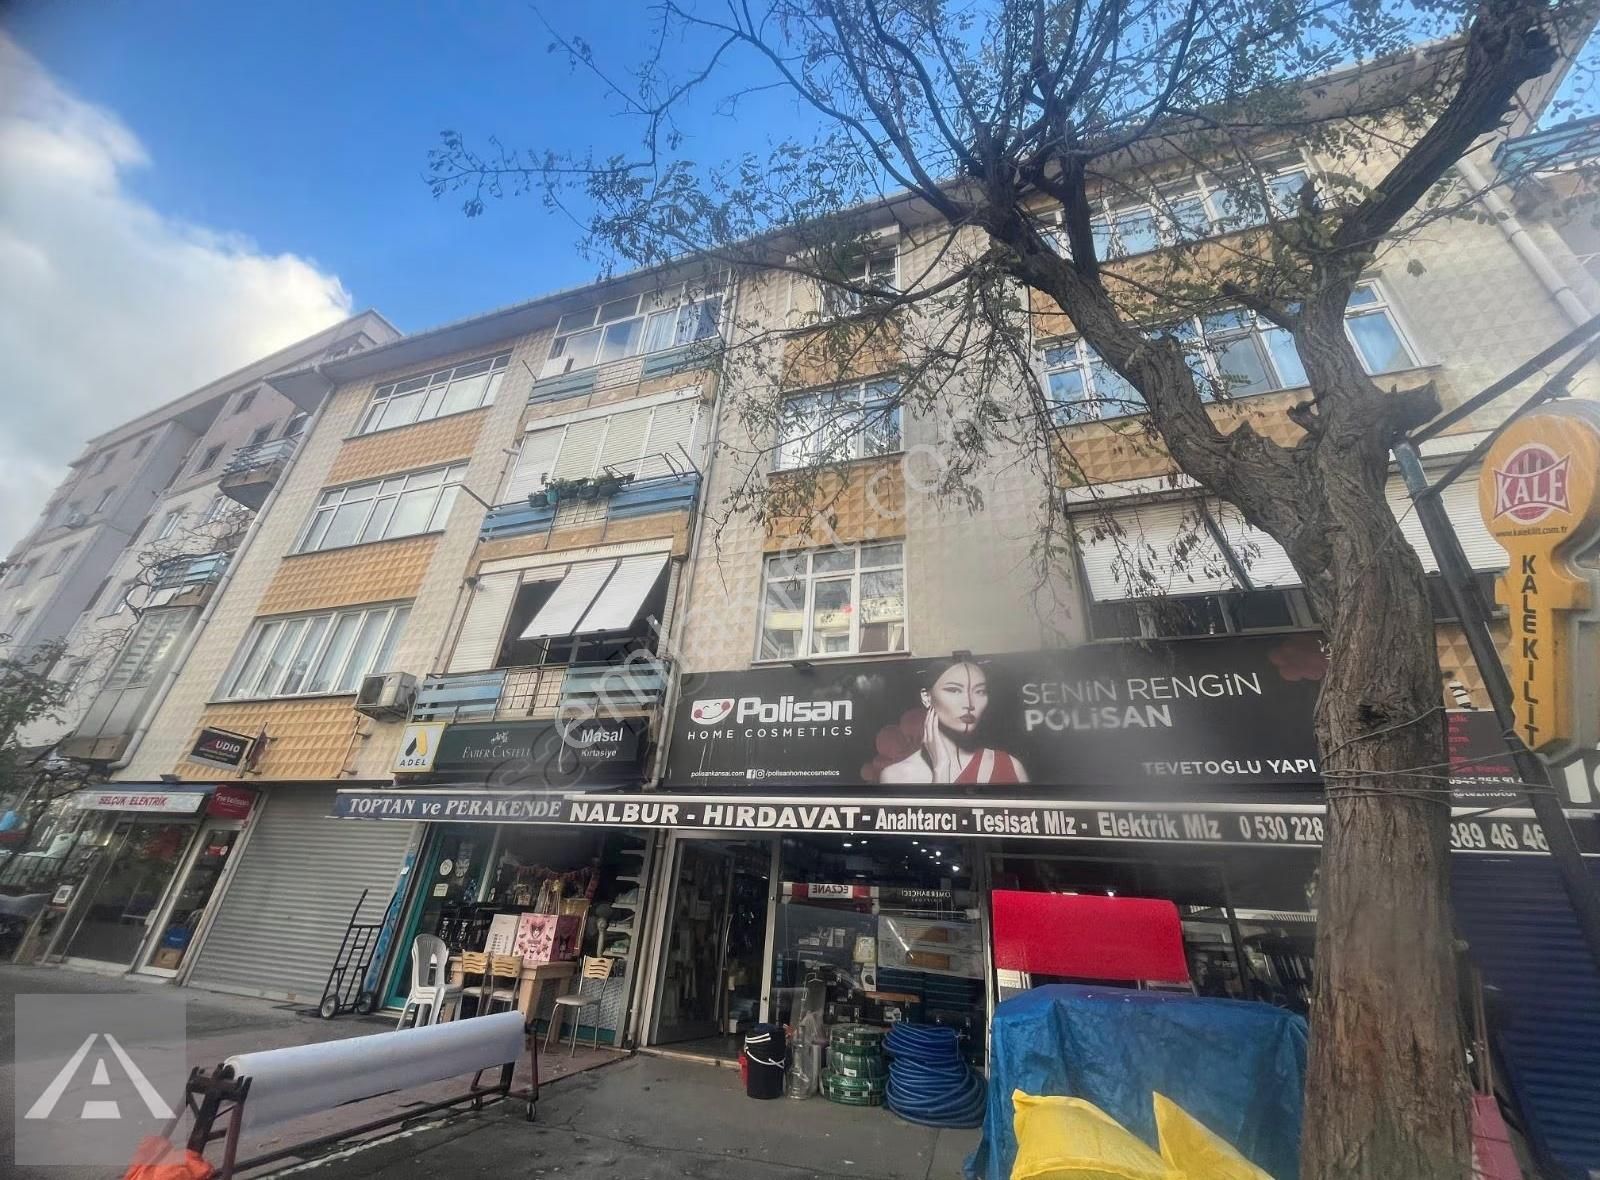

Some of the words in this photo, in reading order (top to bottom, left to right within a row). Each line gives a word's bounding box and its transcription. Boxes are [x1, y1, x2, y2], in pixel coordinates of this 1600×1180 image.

[1495, 458, 1567, 517] KALE
[736, 695, 853, 724] Polisan
[581, 728, 624, 743] Masal
[688, 729, 735, 740] HOME
[745, 725, 853, 737] COSMETICS
[399, 758, 427, 767] ADEL
[1267, 759, 1317, 774] YAPI
[349, 798, 416, 814] TOPTAN
[422, 801, 440, 815] ve
[445, 800, 562, 817] PERAKENDE
[569, 803, 679, 824] NALBUR
[702, 804, 860, 828] HIRDAVAT
[972, 809, 1039, 834] Tesisat
[1097, 811, 1179, 839] Elektrik
[1239, 816, 1251, 840] 0
[1255, 816, 1288, 841] 530
[1291, 816, 1324, 841] 228
[1450, 822, 1486, 848] 389
[1491, 823, 1518, 849] 46
[1523, 824, 1550, 851] 46
